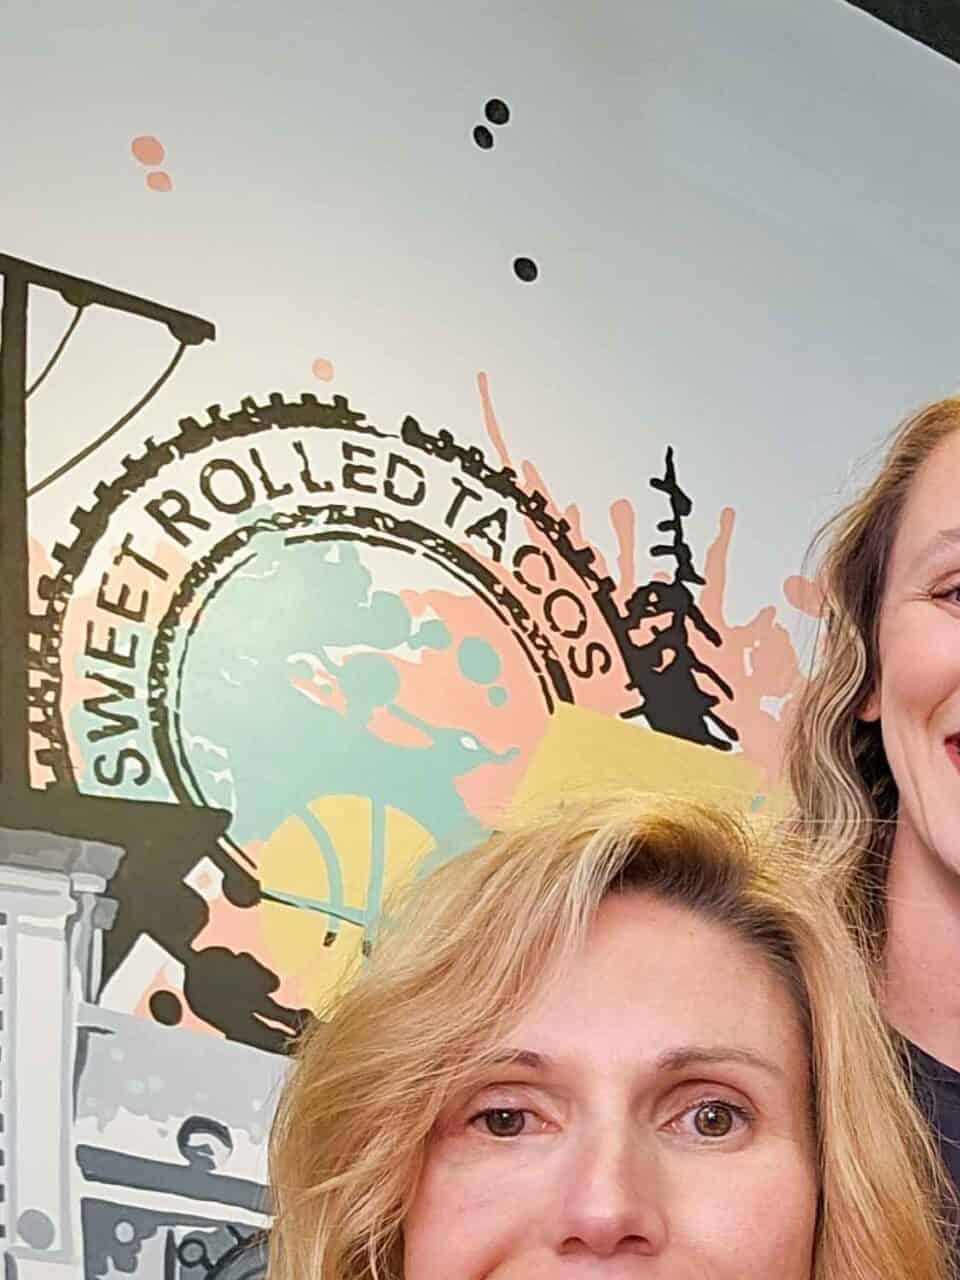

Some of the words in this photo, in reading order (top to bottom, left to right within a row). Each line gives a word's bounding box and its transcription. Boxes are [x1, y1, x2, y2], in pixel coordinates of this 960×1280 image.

[84, 533, 169, 787] SWEET
[145, 442, 426, 546] ROLLED
[442, 478, 612, 680] TACOS
